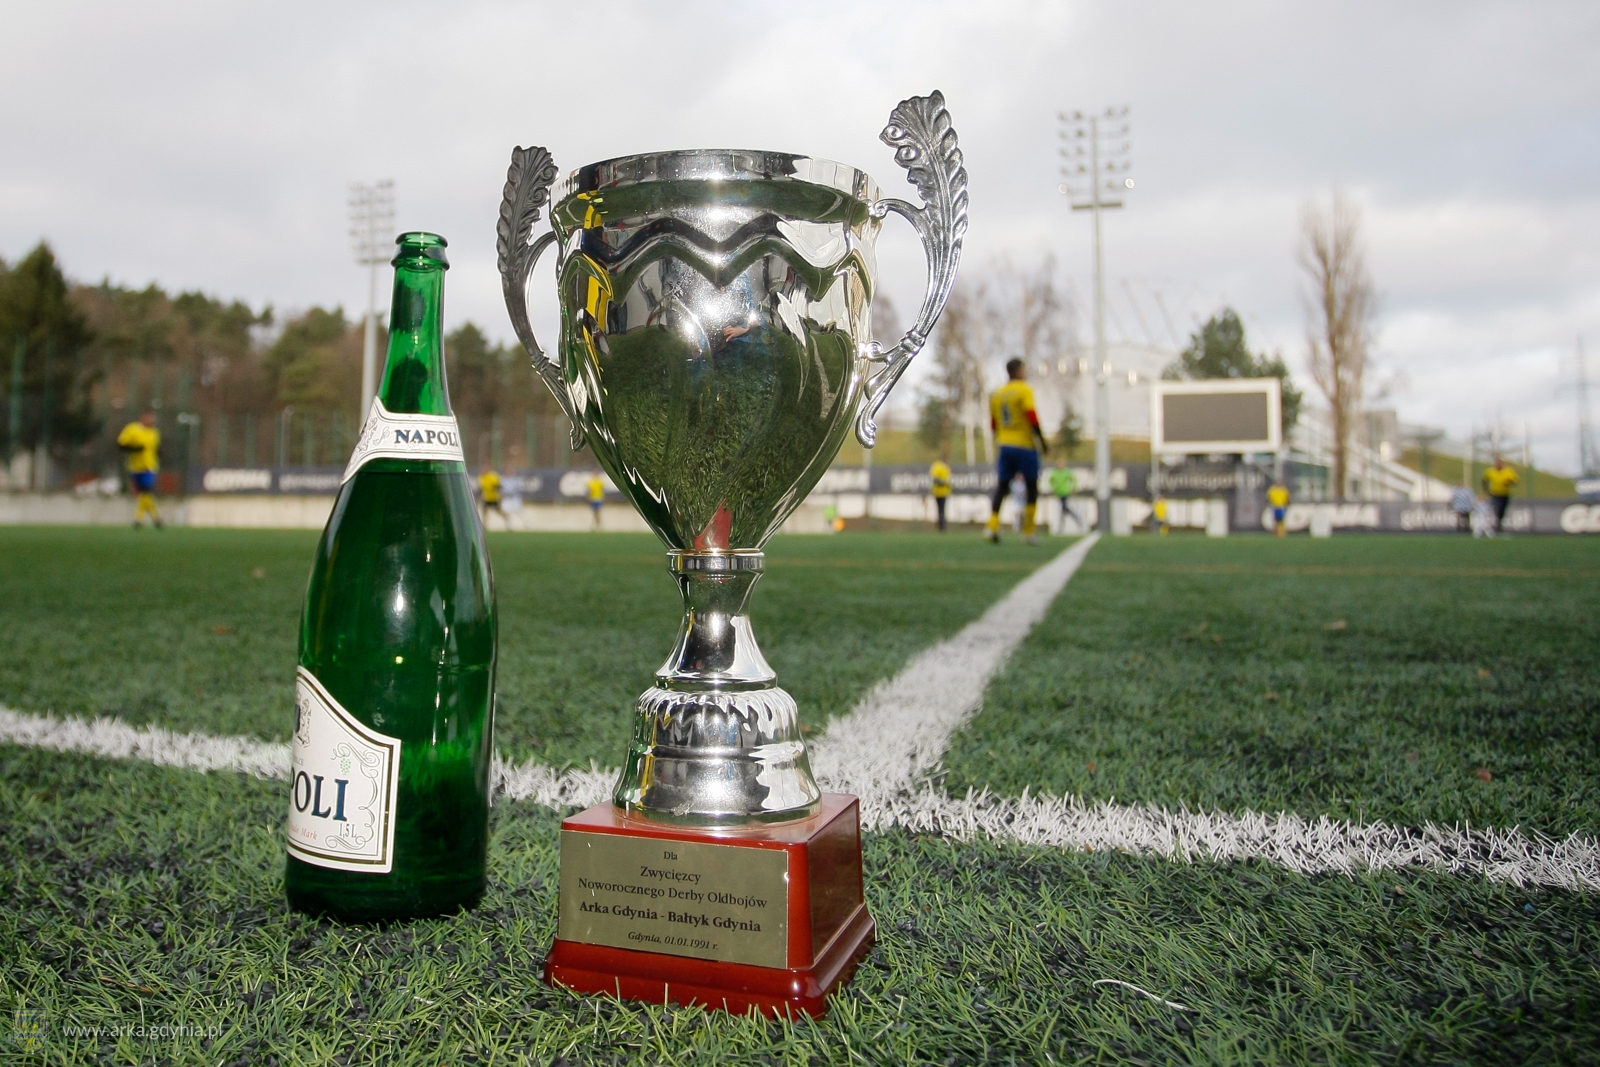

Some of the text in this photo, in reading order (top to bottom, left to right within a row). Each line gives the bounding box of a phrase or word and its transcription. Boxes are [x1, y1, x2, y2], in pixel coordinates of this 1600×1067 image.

[663, 851, 678, 861] Dla
[640, 866, 701, 885] Zwycięzcy
[578, 877, 768, 909] Noworocznego Derby Oldbojów
[579, 901, 609, 914] Arka
[612, 904, 658, 920] Gdynia
[667, 911, 709, 928] Bałtyk
[712, 916, 762, 932] Gdynia
[627, 931, 662, 945] Gdynia,
[664, 935, 710, 950] 01.01.1991
